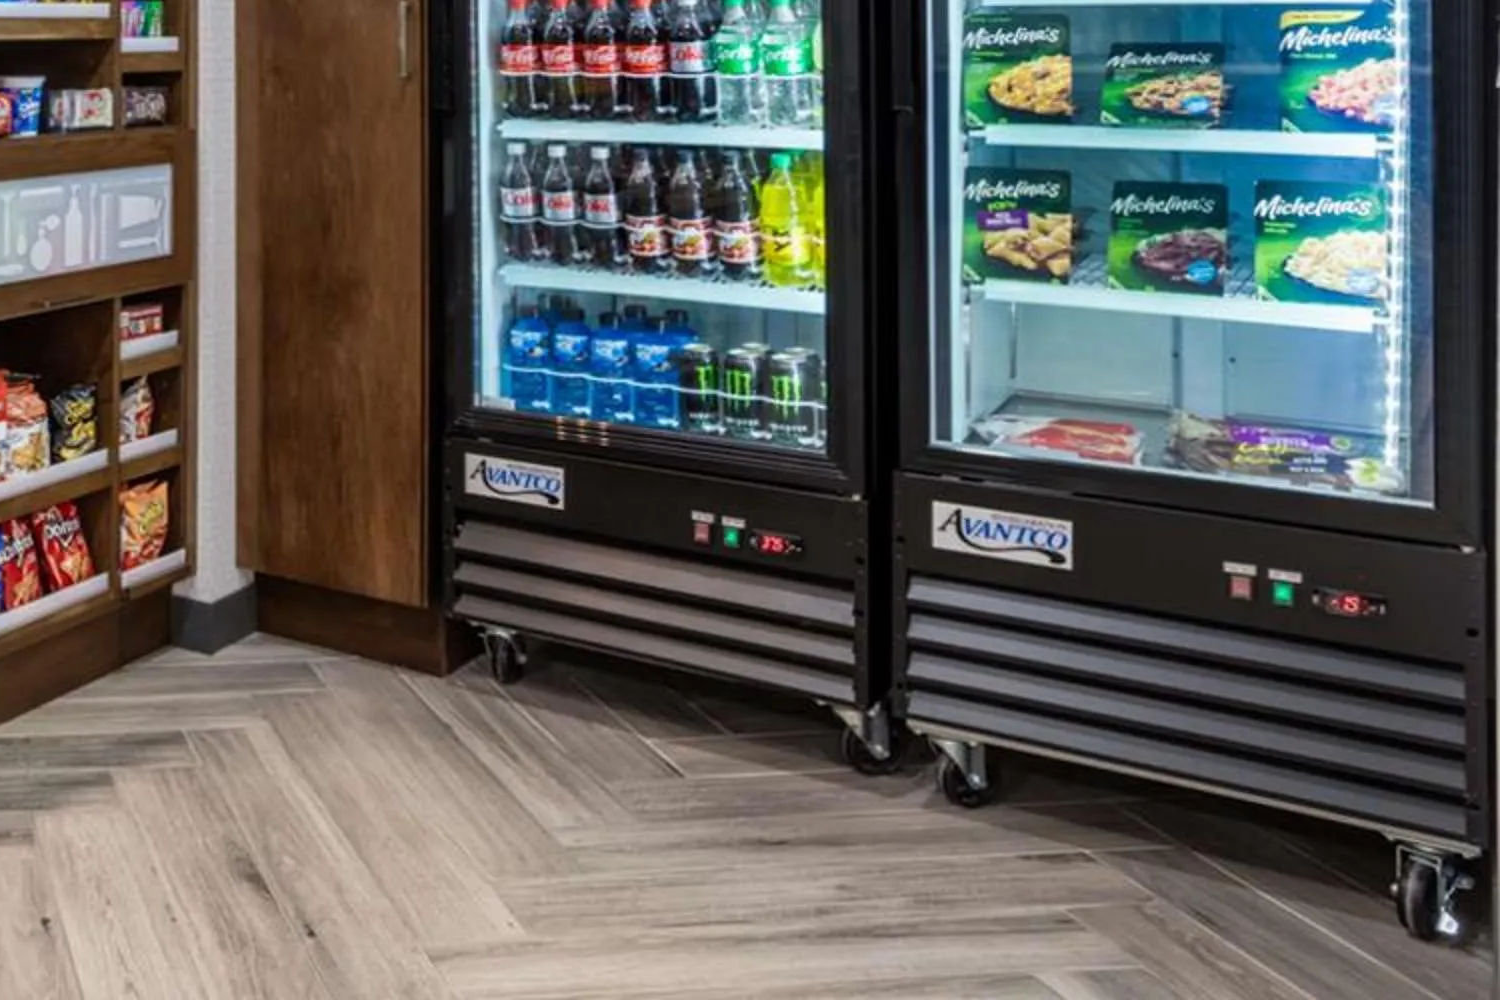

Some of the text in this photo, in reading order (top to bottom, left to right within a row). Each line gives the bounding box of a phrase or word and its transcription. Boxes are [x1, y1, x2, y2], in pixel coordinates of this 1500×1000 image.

[963, 25, 1060, 48] Michelina's
[1279, 25, 1396, 52] Michelina's
[1107, 49, 1212, 68] Michelina's
[963, 179, 1061, 201] Michelina's
[1110, 193, 1216, 216] Michelina's
[1253, 191, 1373, 220] Michelina's
[470, 460, 561, 495] AVANTCO
[938, 507, 1068, 551] AVANTCO
